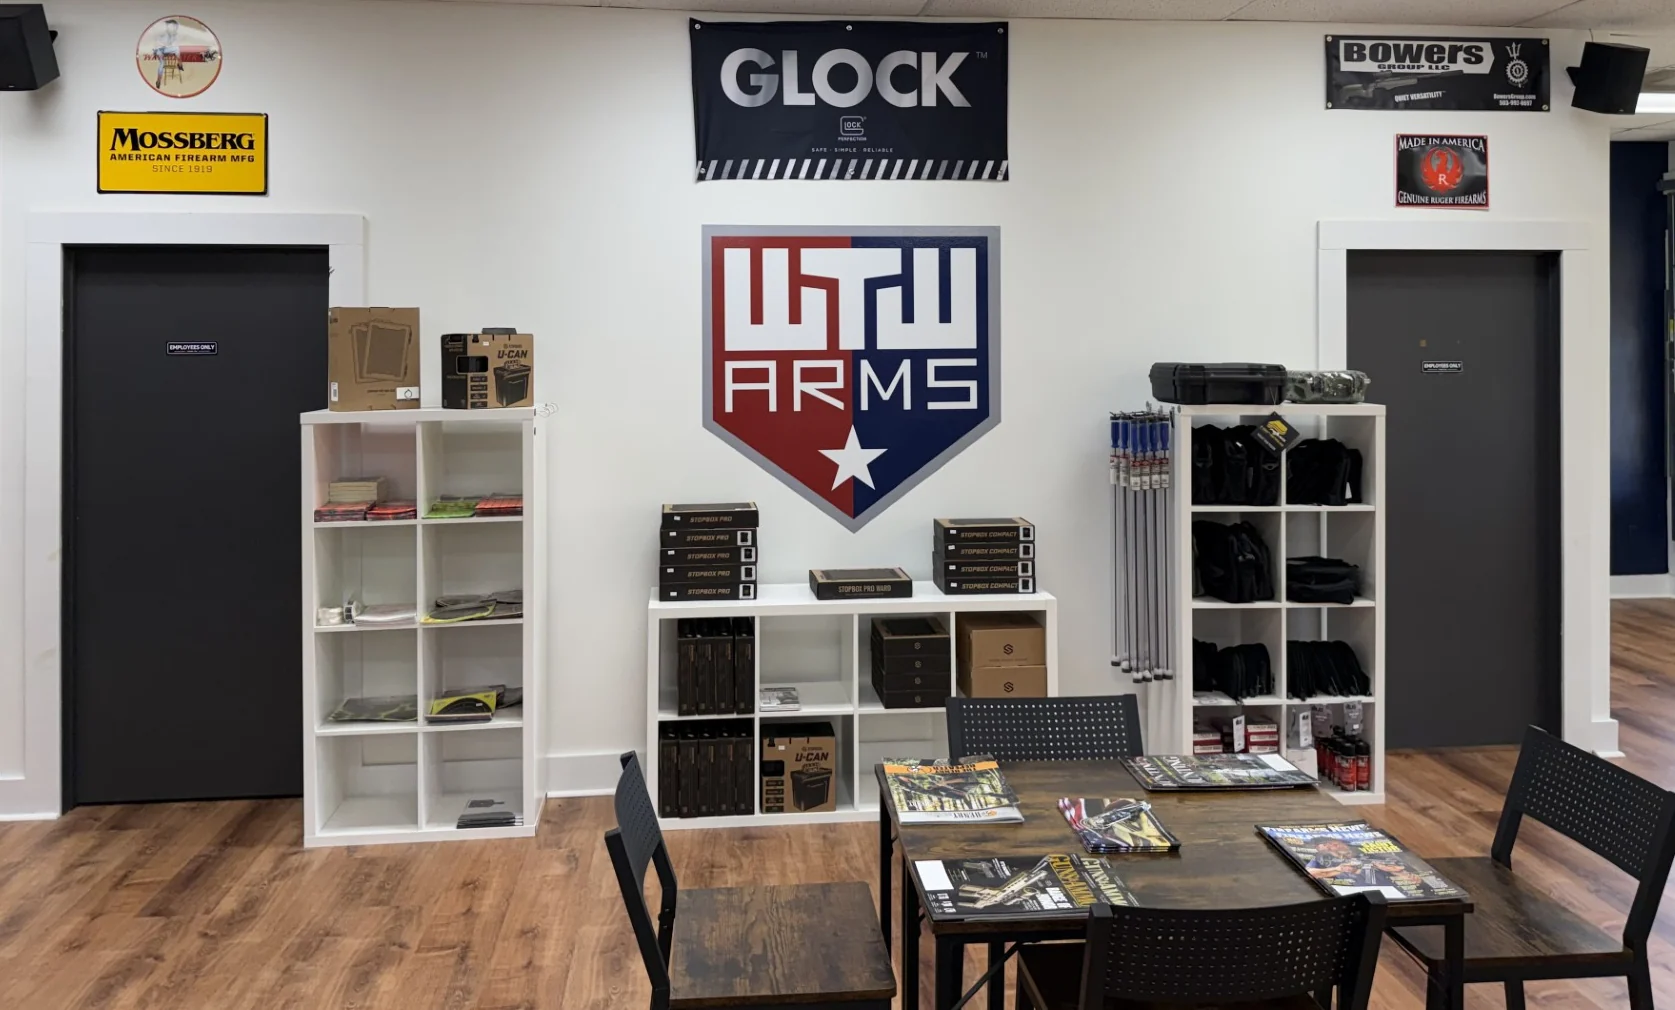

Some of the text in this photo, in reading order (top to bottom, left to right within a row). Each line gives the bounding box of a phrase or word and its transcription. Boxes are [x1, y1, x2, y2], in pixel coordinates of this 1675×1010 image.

[1343, 42, 1484, 65] Bowers
[720, 47, 972, 108] GLOCK
[1394, 91, 1442, 102] QUIET VERSATILITY
[110, 128, 255, 151] MOSSBERG
[1398, 137, 1426, 151] MADE
[1442, 138, 1485, 152] AMERICA
[175, 154, 227, 162] FIREARM
[152, 164, 184, 172] SINCE
[1438, 174, 1449, 185] R
[1398, 191, 1486, 204] GENUINE RUGER FIREARMS
[497, 350, 528, 358] U-CAN
[724, 358, 978, 413] ARMS
[795, 752, 829, 762] U-CAN
